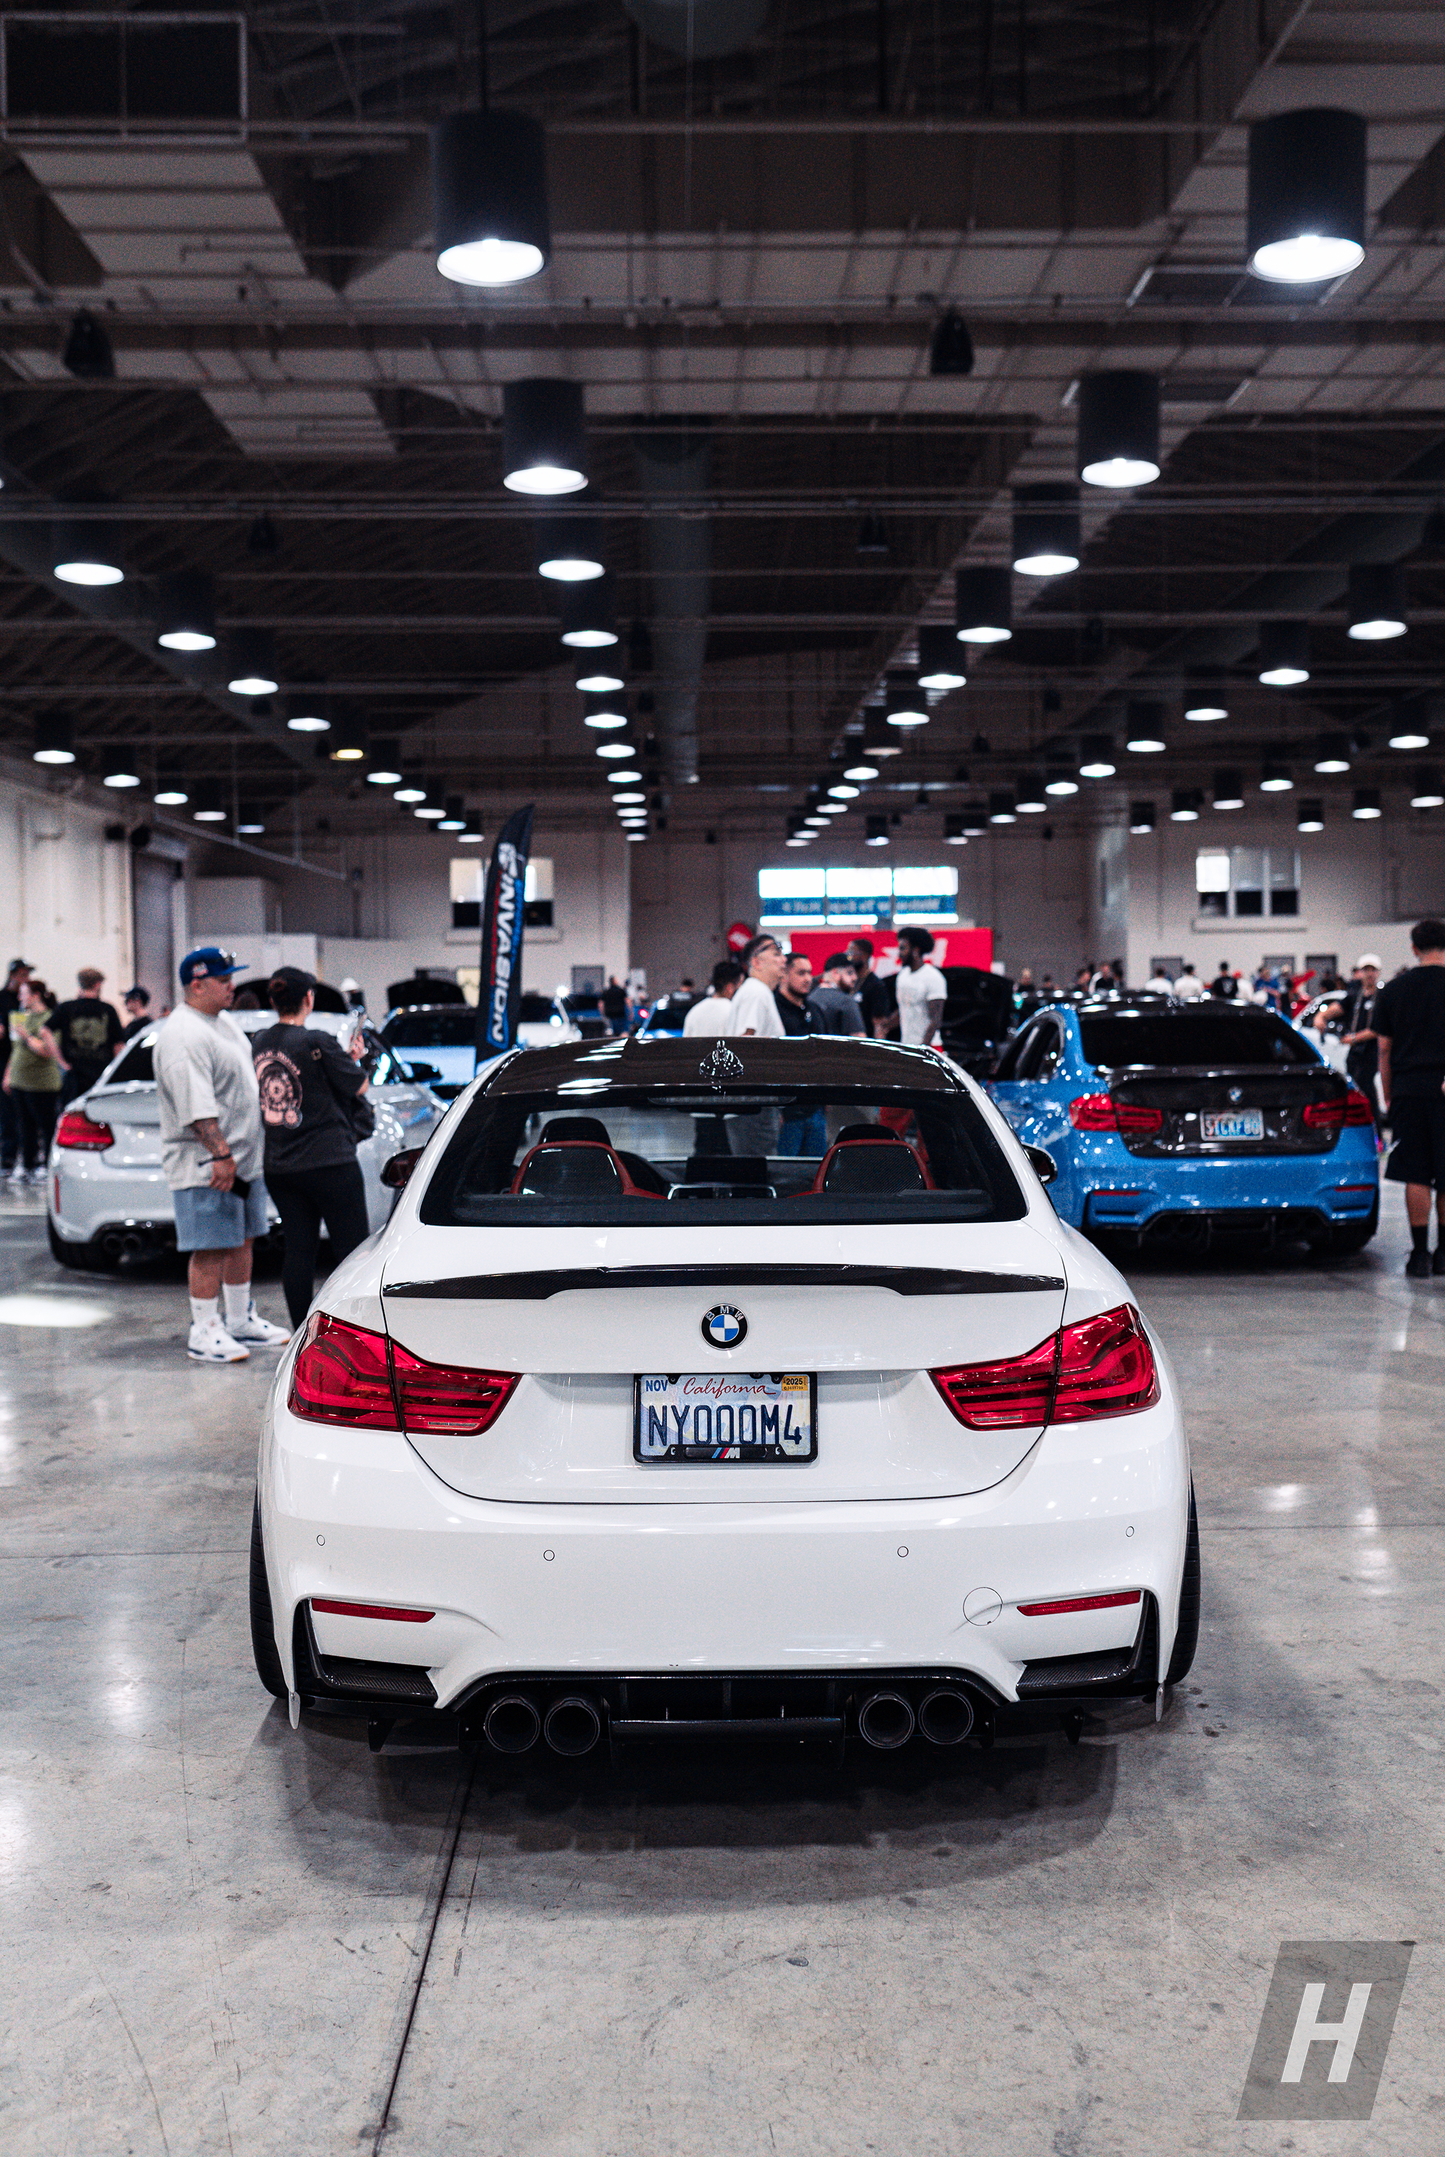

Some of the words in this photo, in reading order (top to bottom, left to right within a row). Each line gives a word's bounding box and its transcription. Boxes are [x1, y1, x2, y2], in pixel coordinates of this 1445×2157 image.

[704, 1305, 745, 1321] BMW
[645, 1379, 668, 1392] NOV
[683, 1376, 777, 1399] California
[785, 1377, 804, 1386] 2025
